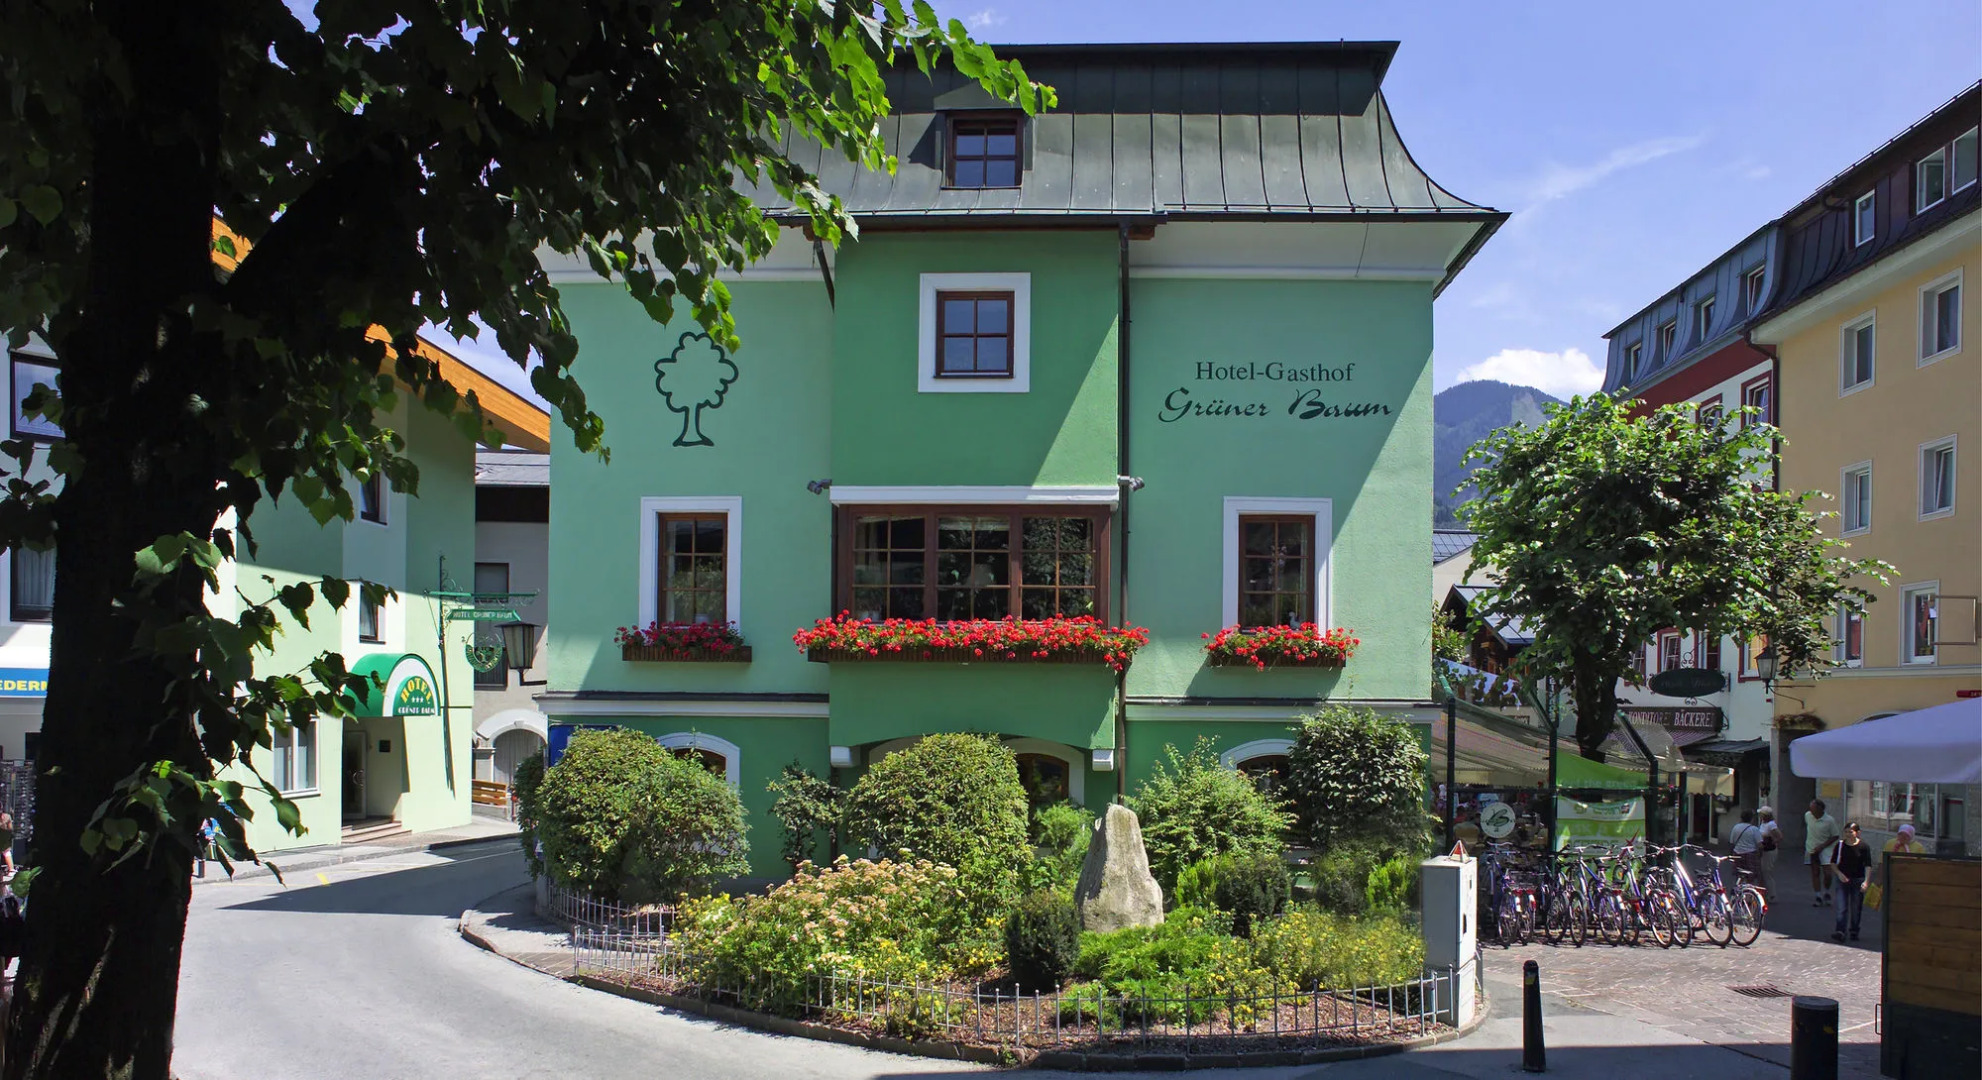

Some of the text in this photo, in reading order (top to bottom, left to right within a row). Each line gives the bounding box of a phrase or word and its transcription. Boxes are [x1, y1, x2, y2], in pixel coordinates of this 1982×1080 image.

[1195, 361, 1356, 382] Hotel-Gasthof
[1158, 386, 1394, 423] Grüner Baum
[400, 677, 432, 704] HOTEL
